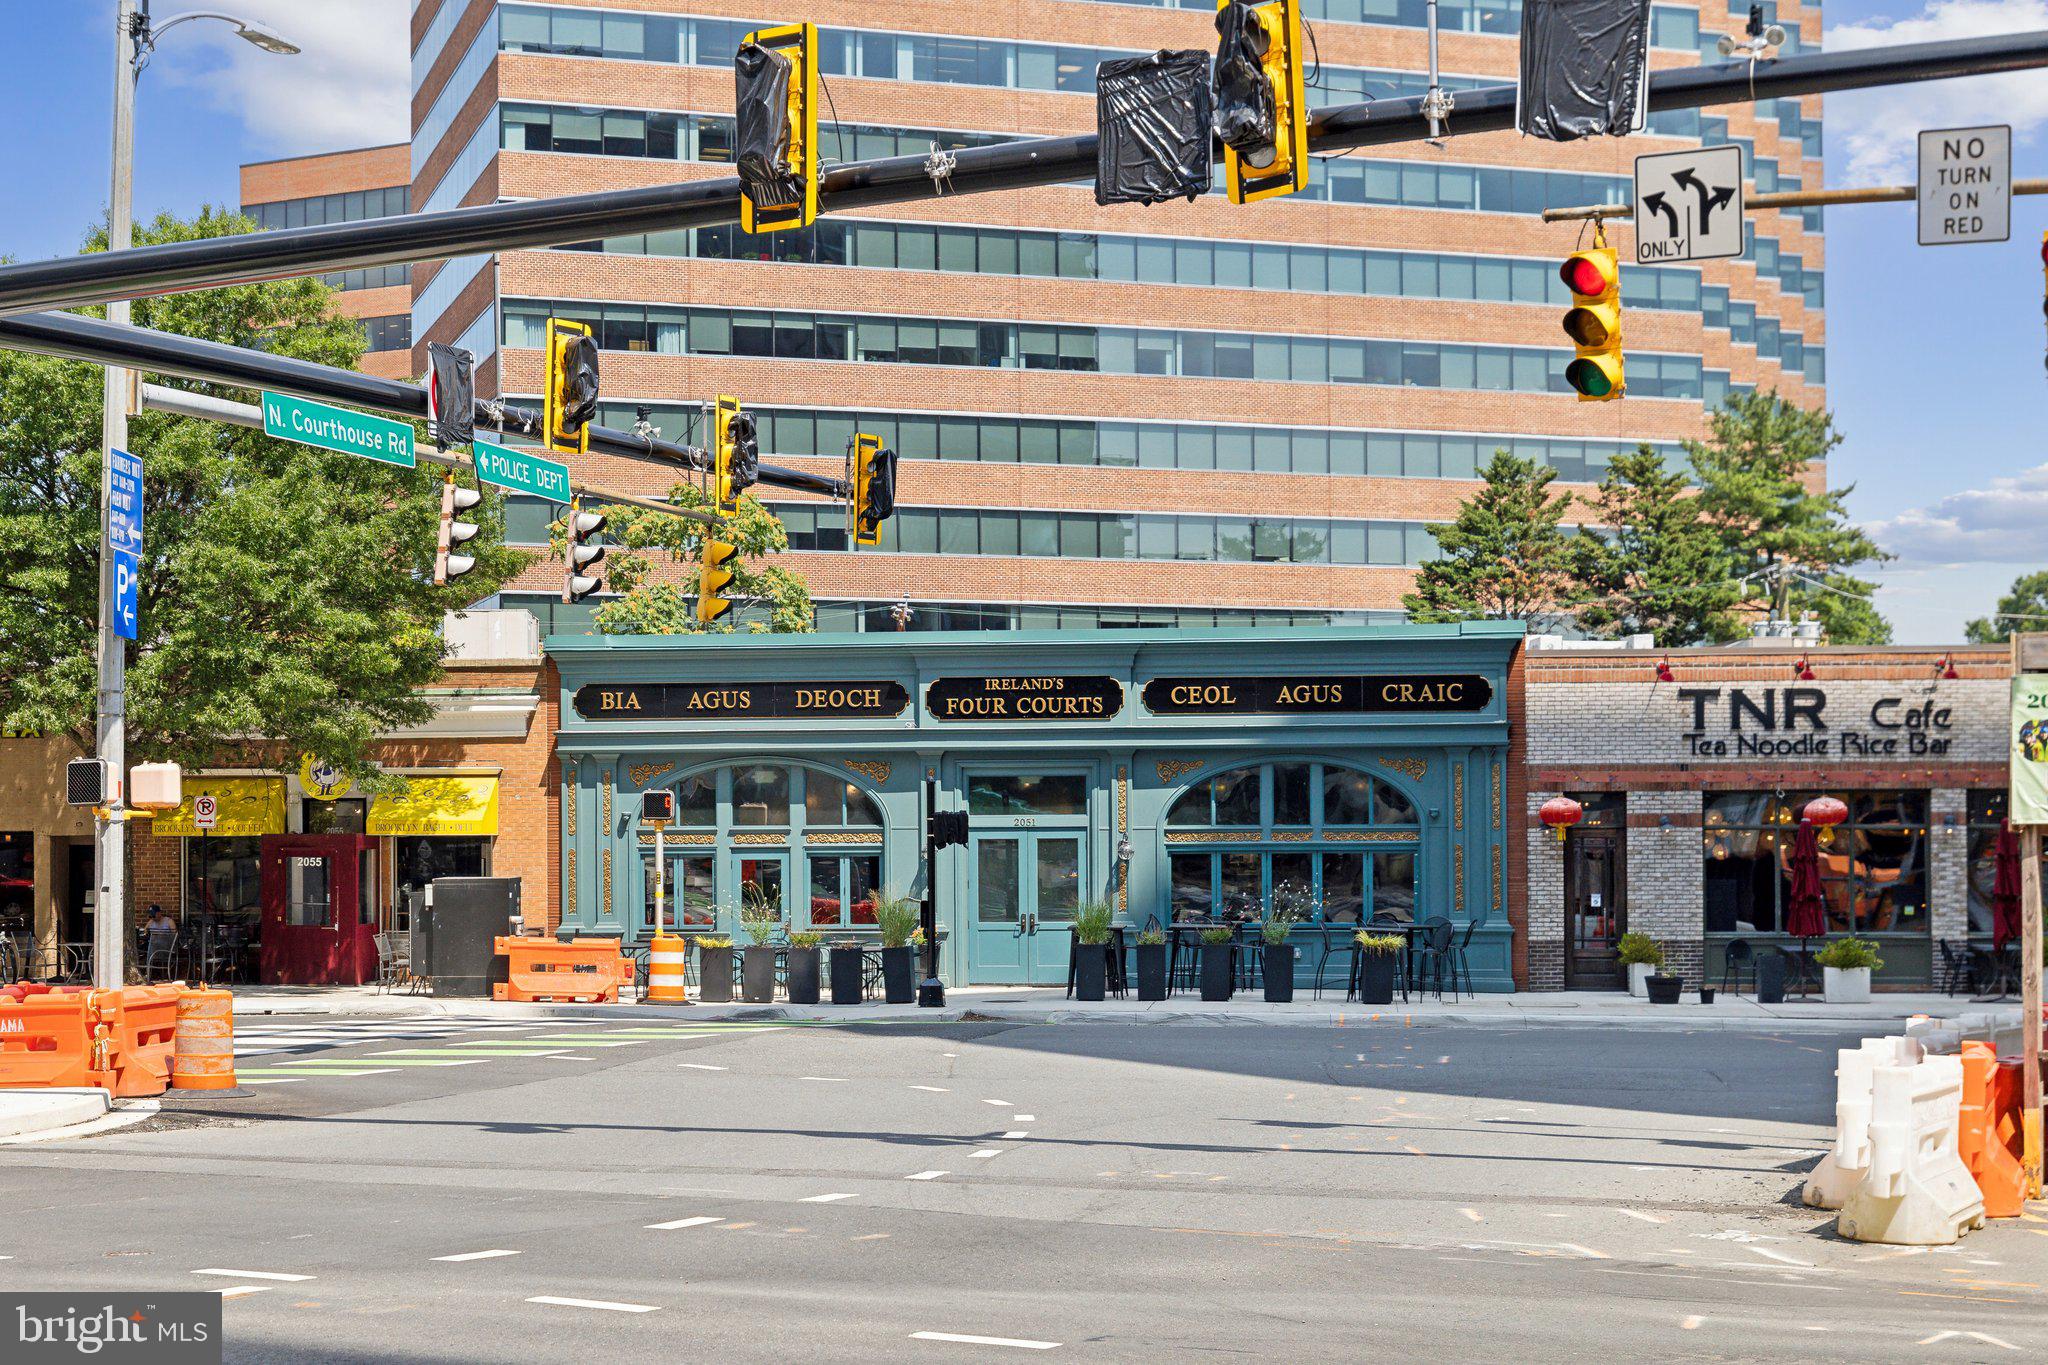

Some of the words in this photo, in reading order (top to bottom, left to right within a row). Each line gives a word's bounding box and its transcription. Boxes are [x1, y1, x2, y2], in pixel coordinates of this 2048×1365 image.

[1944, 138, 1984, 160] NO
[1938, 166, 1991, 186] TURN
[1950, 192, 1979, 210] ON
[1944, 216, 1983, 234] RED
[1641, 239, 1685, 258] ONLY
[268, 403, 286, 428] N.
[292, 408, 382, 450] Courthouse
[388, 431, 411, 457] Rd.
[491, 454, 531, 484] POLICE
[536, 467, 563, 493] DEPT
[117, 564, 129, 612] P
[985, 678, 1064, 691] IRELAND'S
[1171, 685, 1237, 705] CEOL
[1276, 684, 1343, 704] AGUS
[1382, 683, 1463, 703] CRAIC
[601, 691, 641, 710] BIA
[687, 690, 751, 710] AGUS
[795, 689, 881, 709] DEOCH
[946, 697, 1013, 715] FOUR
[1016, 696, 1104, 715] COURTS
[1677, 688, 1827, 730] TNR
[1682, 733, 1727, 756] Tea
[1738, 733, 1829, 756] Noodle
[1840, 732, 1898, 755] Rice
[1908, 732, 1952, 755] Bar
[154, 824, 197, 832] BROOKLYN
[233, 824, 263, 832] COFFEE
[376, 823, 418, 832] BROOKLYN
[423, 823, 446, 832] BAGEL
[1013, 818, 1036, 827] 2051
[297, 857, 322, 867] 2055
